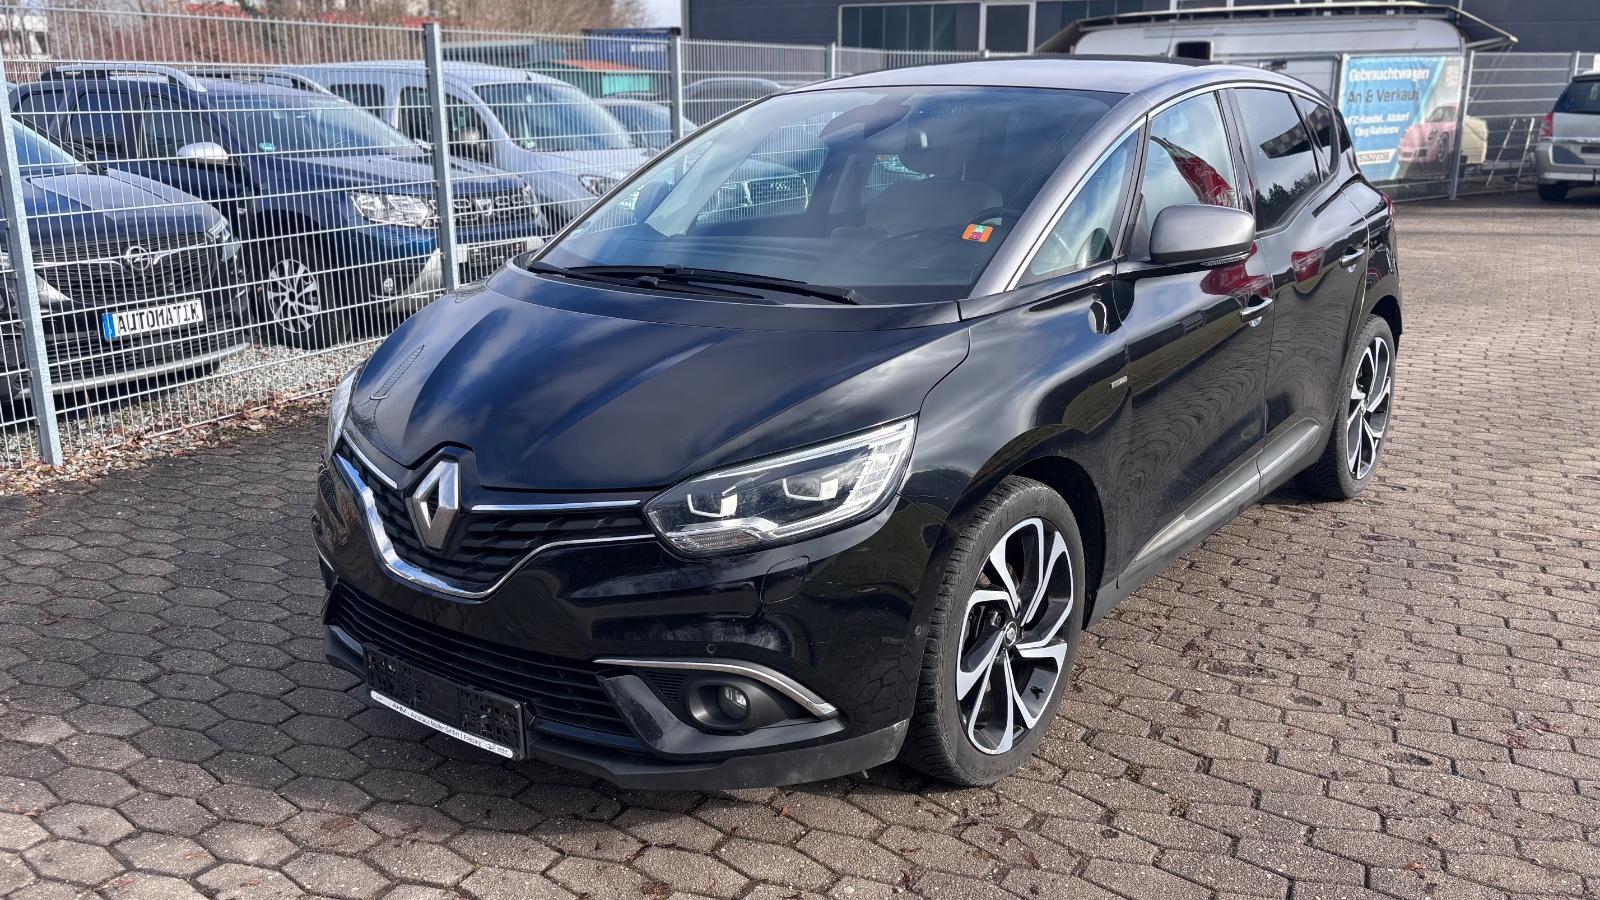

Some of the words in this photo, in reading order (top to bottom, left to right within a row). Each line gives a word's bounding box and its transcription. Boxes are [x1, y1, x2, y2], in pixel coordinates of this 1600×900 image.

[1349, 67, 1430, 82] Gebrauchtwagen
[1347, 91, 1362, 104] An
[1365, 89, 1374, 103] &
[1377, 88, 1420, 103] Verkauf
[117, 302, 200, 333] AUTOMATIK
